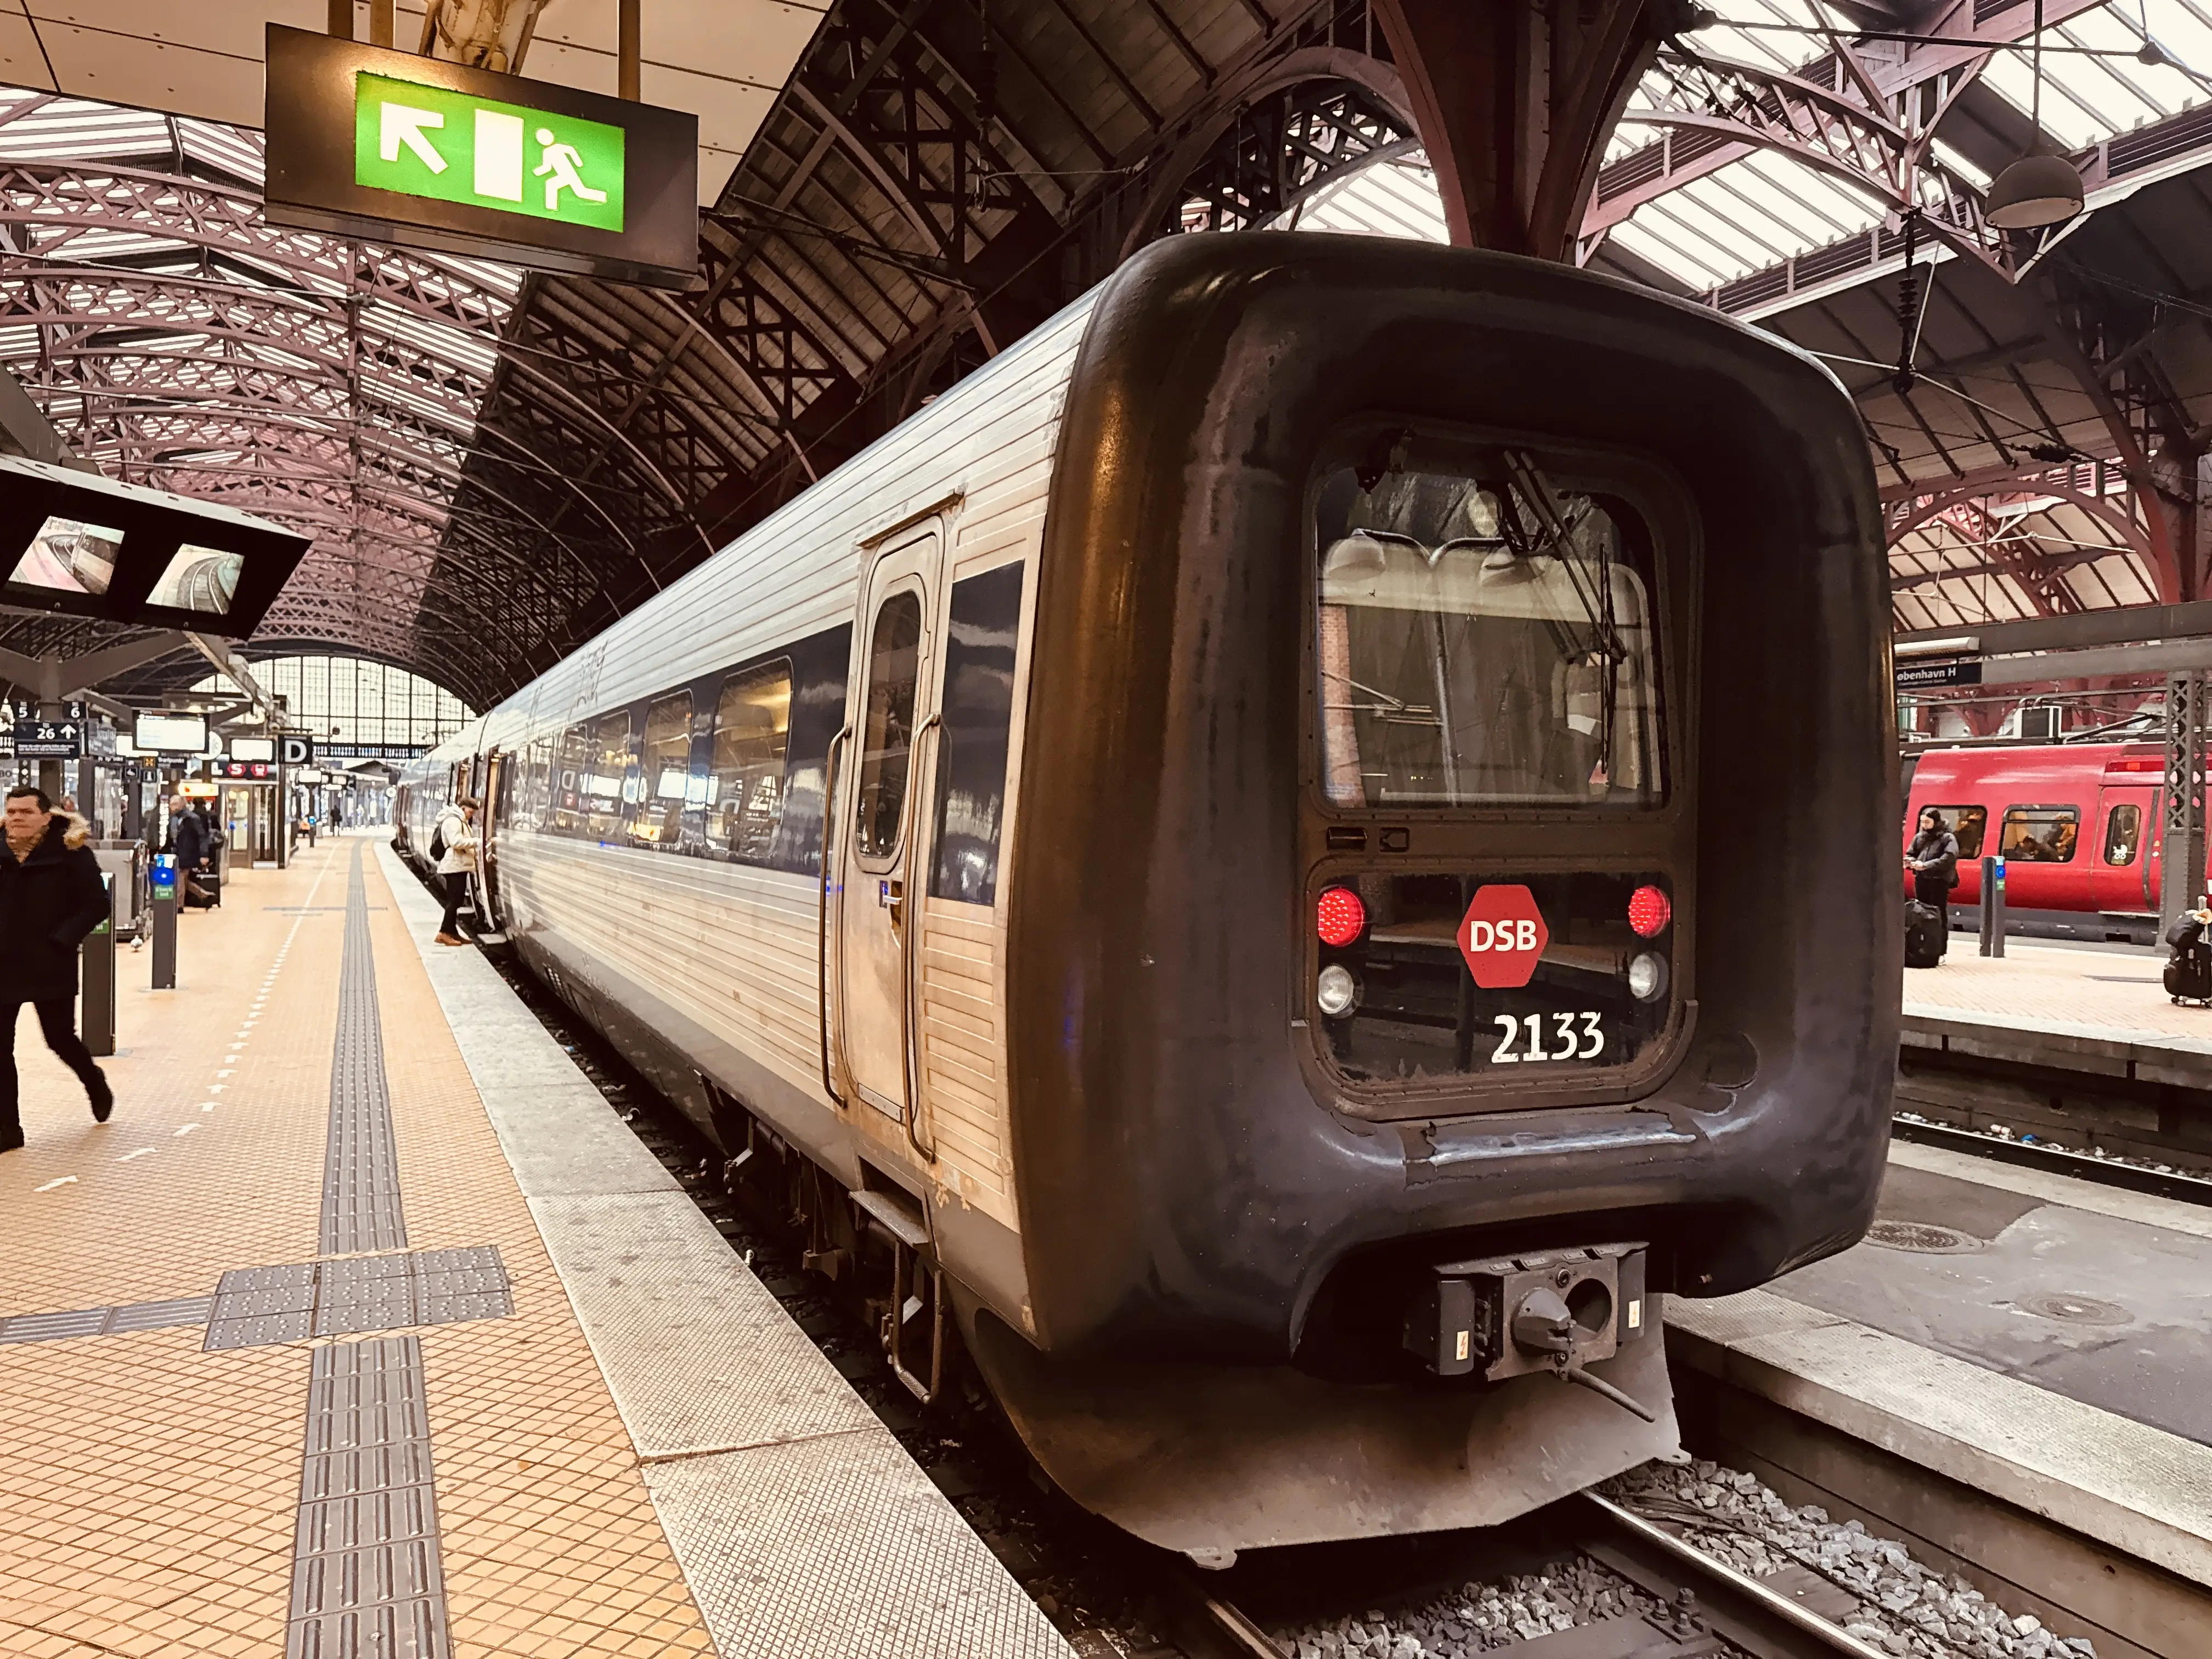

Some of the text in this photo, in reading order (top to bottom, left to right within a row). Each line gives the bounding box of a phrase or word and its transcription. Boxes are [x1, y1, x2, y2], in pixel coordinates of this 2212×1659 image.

[1897, 667, 1956, 681] øbenhavn H
[19, 707, 28, 718] 5
[71, 707, 80, 718] 6
[37, 728, 55, 740] 26
[284, 740, 307, 763] D
[230, 763, 243, 775] S
[1470, 919, 1537, 952] DSB
[1491, 1012, 1604, 1063] 2133
